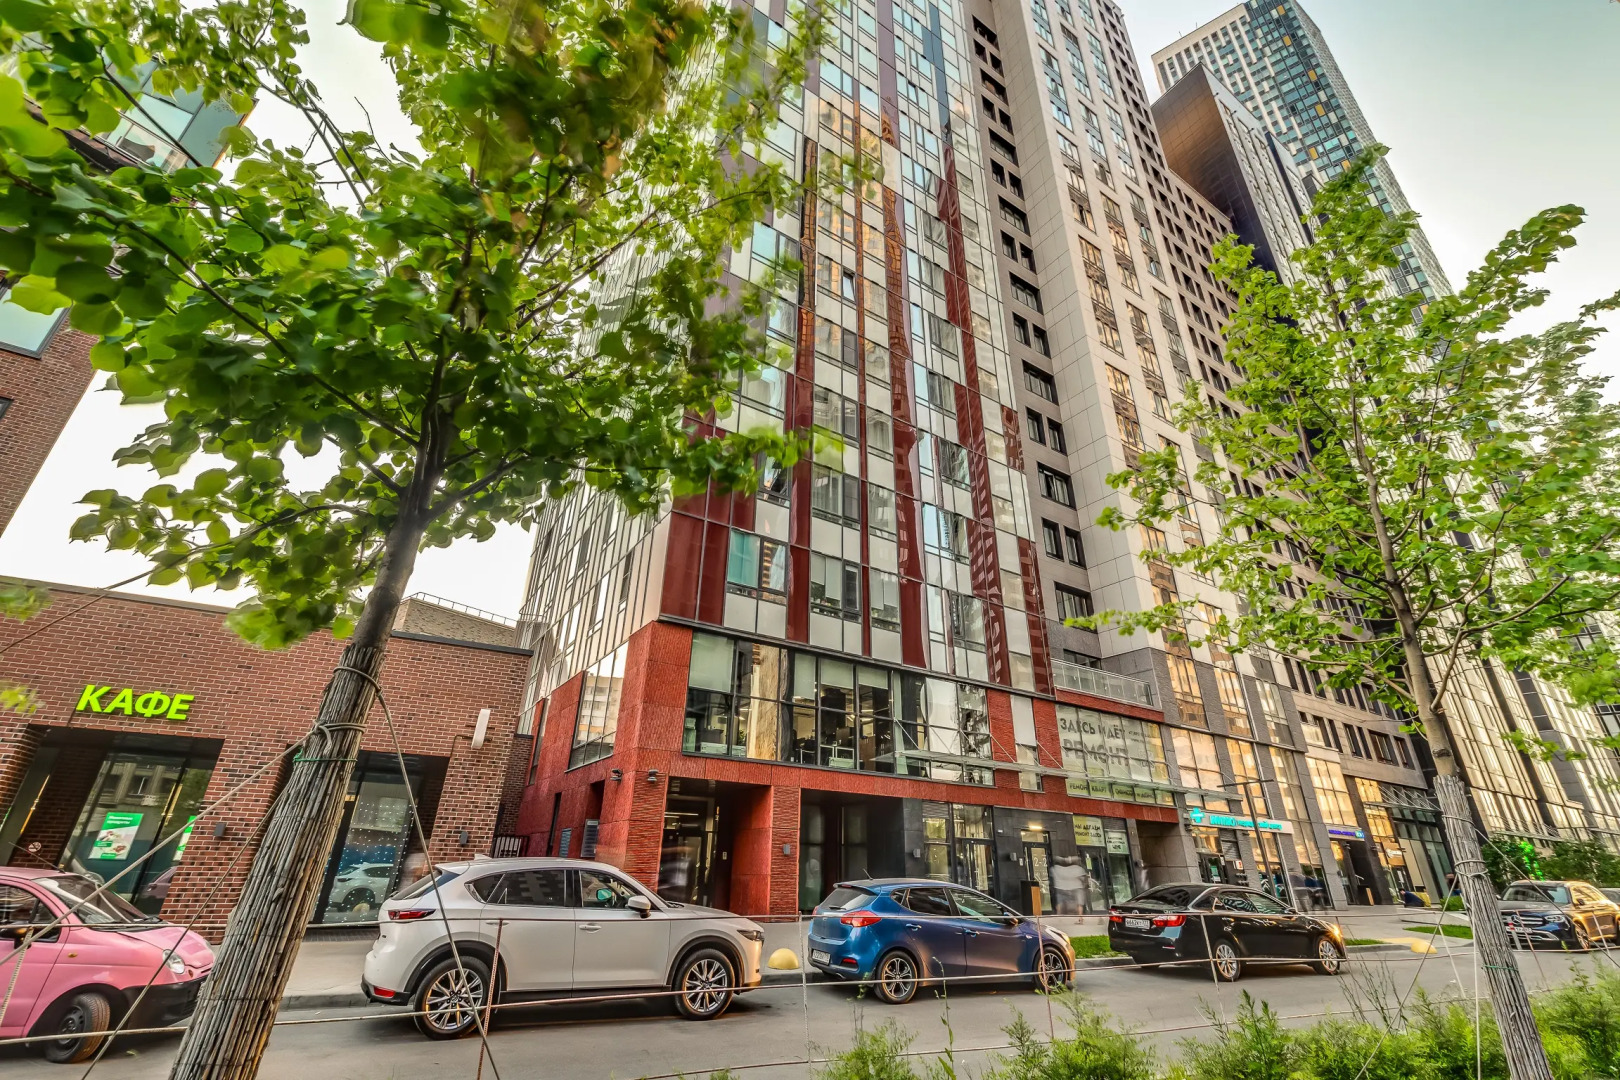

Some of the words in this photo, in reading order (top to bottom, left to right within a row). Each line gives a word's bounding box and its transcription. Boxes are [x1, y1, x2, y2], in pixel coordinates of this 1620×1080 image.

[76, 684, 195, 720] КАФЕ
[1060, 718, 1096, 735] ЗДЕСЬ
[1098, 724, 1126, 739] ИДЁТ
[1063, 738, 1129, 767] РЕМОНТ
